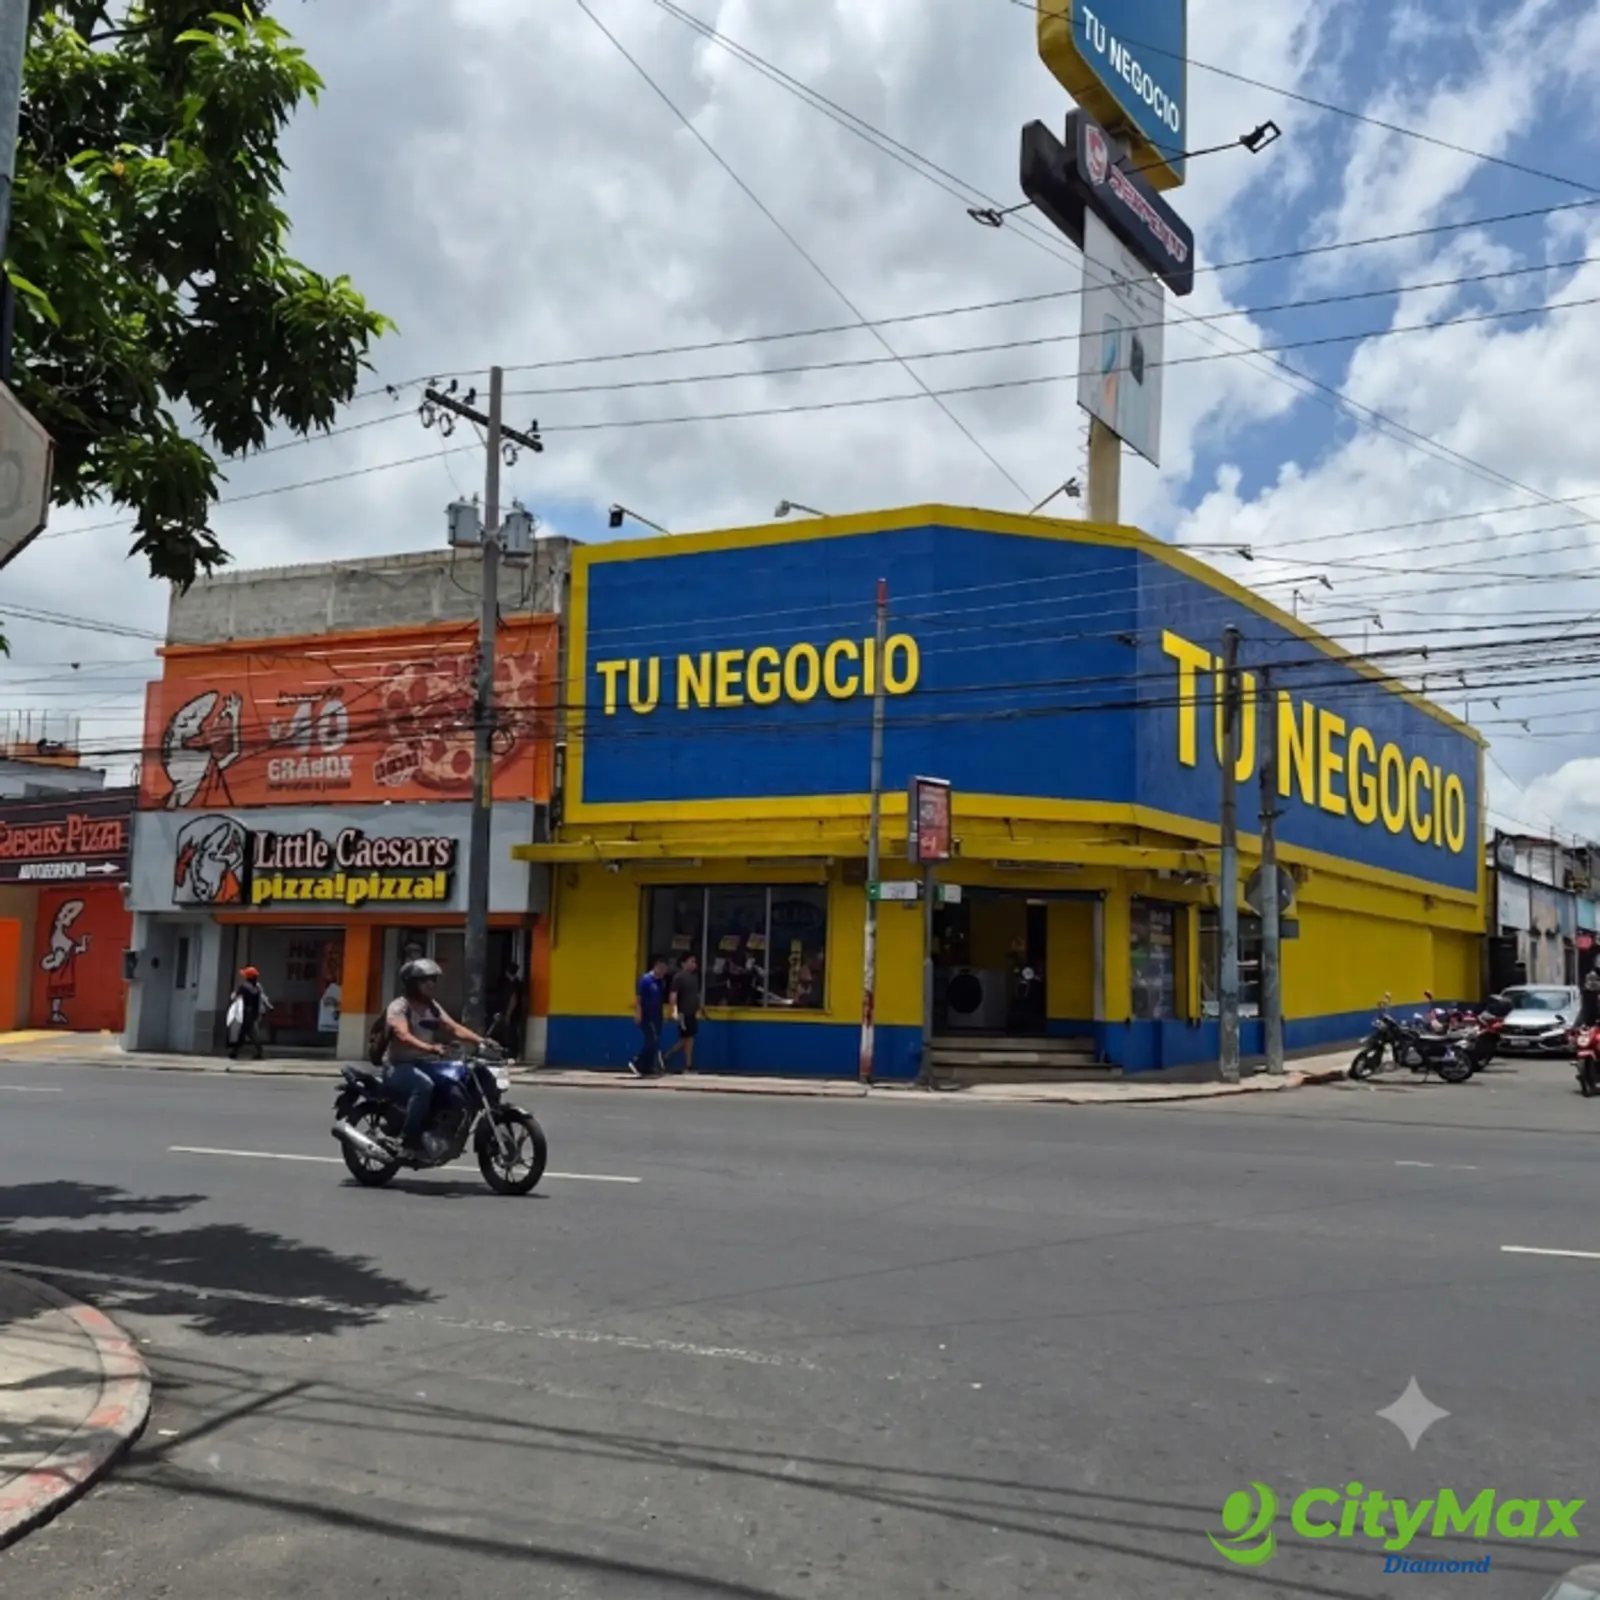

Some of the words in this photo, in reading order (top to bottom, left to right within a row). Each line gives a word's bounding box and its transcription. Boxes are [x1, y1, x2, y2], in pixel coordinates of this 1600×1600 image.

[1082, 5, 1106, 53] TU
[1110, 36, 1180, 133] NEGOCIO
[596, 657, 660, 714] TU
[676, 633, 920, 709] NEGOCIO
[1162, 629, 1256, 782] TU
[1278, 689, 1466, 853] NEGOCIO
[66, 813, 121, 854] Pizza
[254, 830, 329, 868] Little
[336, 829, 450, 867] Caesars
